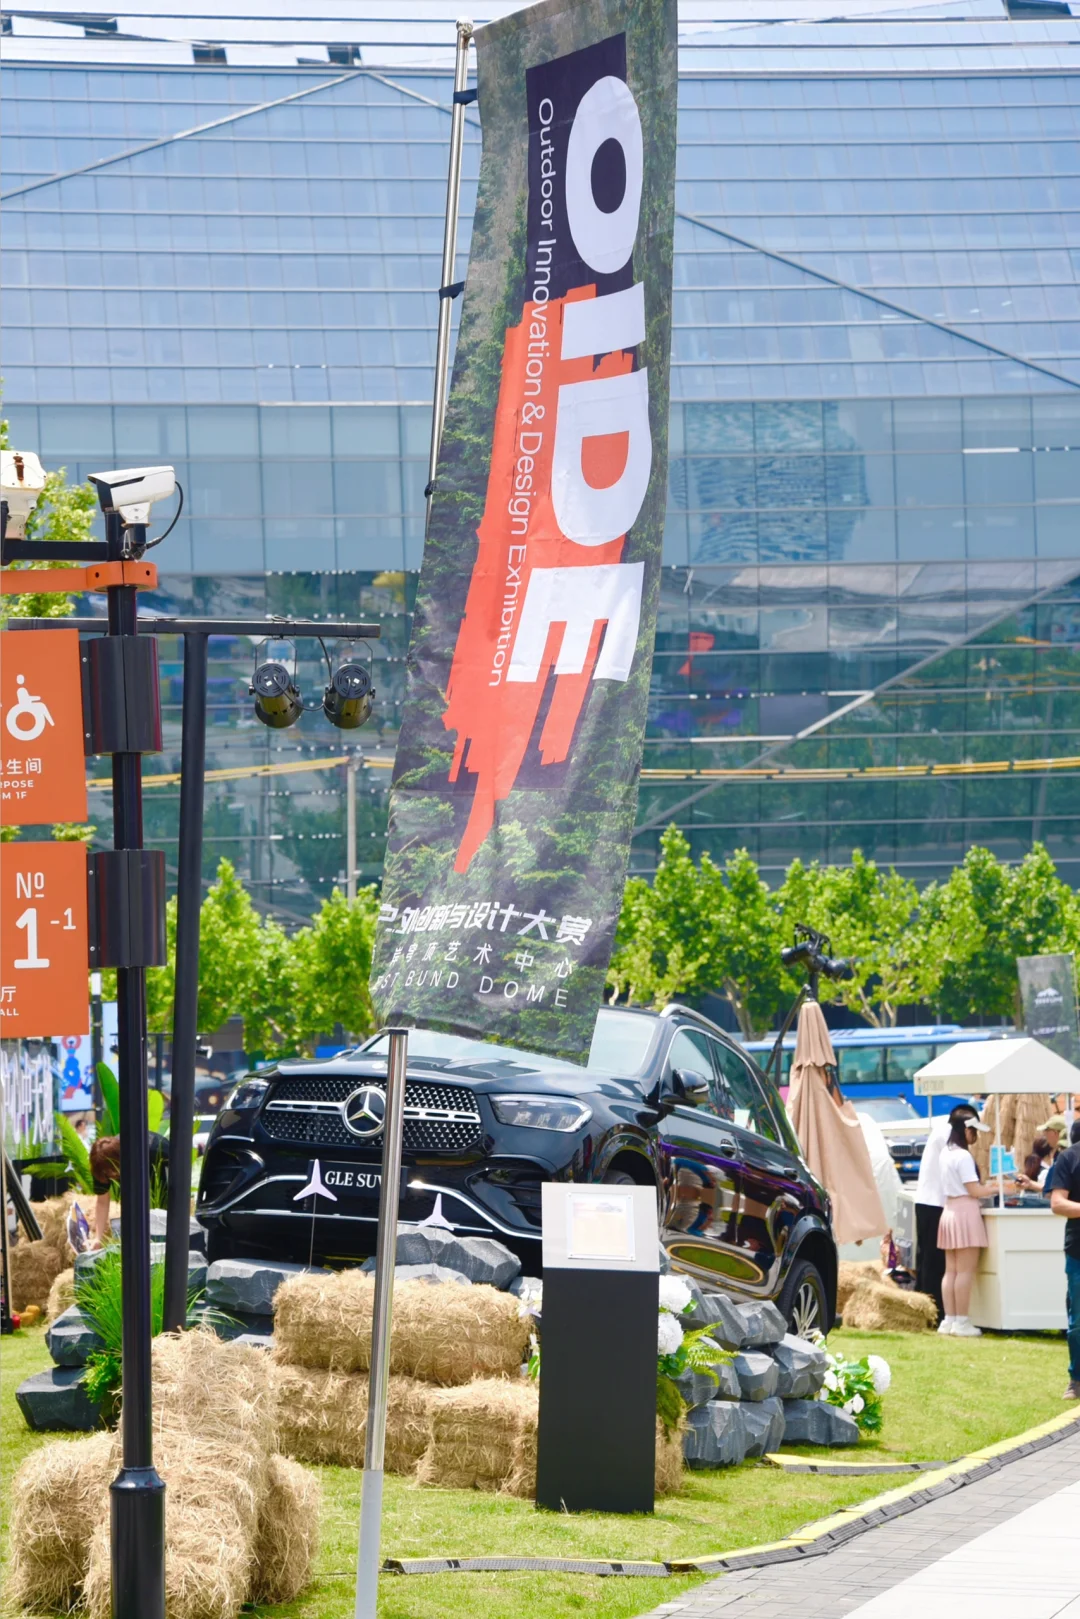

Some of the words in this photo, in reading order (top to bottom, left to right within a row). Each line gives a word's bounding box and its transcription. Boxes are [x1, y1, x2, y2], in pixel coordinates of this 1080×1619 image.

[538, 98, 557, 231] Outdoor
[523, 238, 557, 397] Innovation
[505, 75, 652, 683] OIDE
[521, 402, 546, 425] &
[508, 431, 543, 535] Design
[488, 544, 528, 687] Exhibition
[0, 757, 42, 775] 生间
[15, 791, 28, 800] 1F
[405, 970, 460, 989] BUND
[478, 975, 569, 1008] DOME
[324, 1170, 354, 1187] GLE
